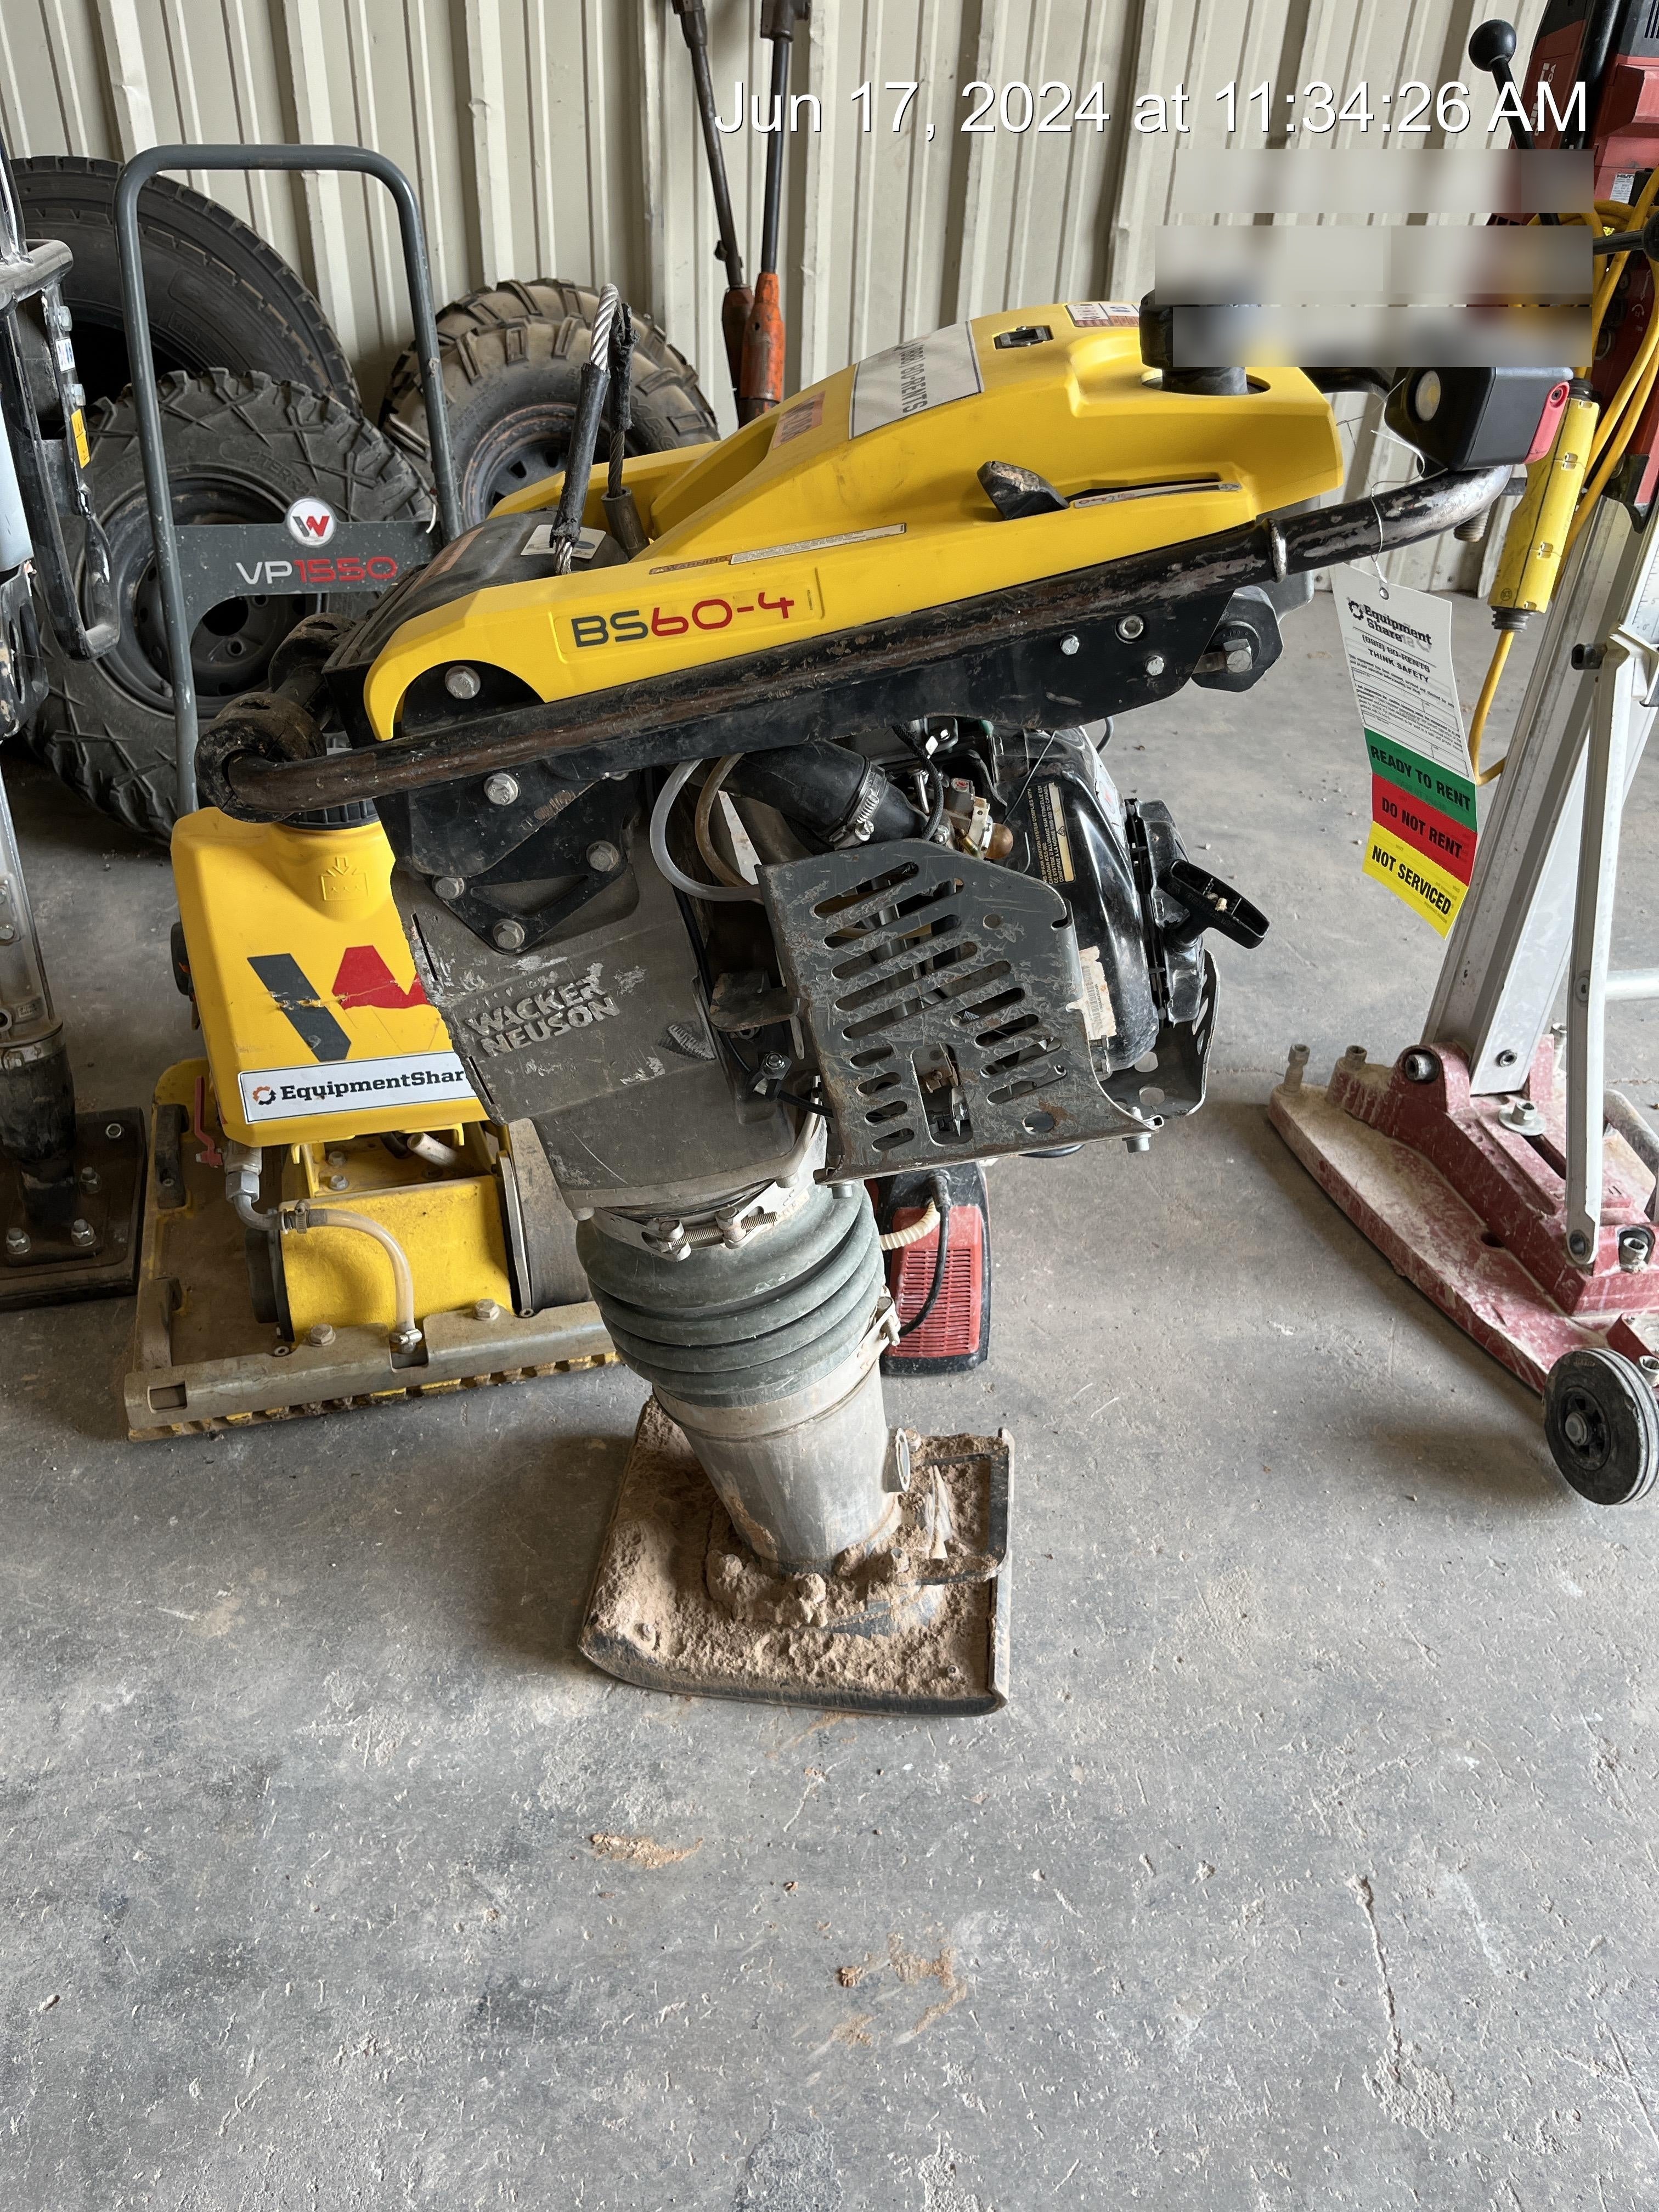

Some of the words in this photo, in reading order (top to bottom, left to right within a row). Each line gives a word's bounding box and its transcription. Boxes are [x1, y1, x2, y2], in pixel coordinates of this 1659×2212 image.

[901, 364, 928, 413] 80-RENTS
[235, 556, 398, 585] VP1550
[571, 592, 794, 647] BS60-4
[1363, 604, 1432, 645] Equipment
[1367, 617, 1402, 642] Share
[1368, 648, 1395, 667] THINK
[1397, 662, 1429, 682] SAFETY
[1370, 745, 1412, 778] READY
[1415, 769, 1432, 789] TO
[1436, 780, 1470, 811] RENT
[1382, 797, 1397, 819] DO
[1402, 809, 1426, 836] NOT
[1429, 826, 1462, 859] RENT
[1056, 857, 1064, 883] CONFORME
[1372, 845, 1396, 872] NOT
[1398, 863, 1451, 915] SERVICED
[465, 969, 607, 1036] WACKER
[481, 997, 620, 1057] NEUSON
[280, 1070, 466, 1101] EquipmentShar
